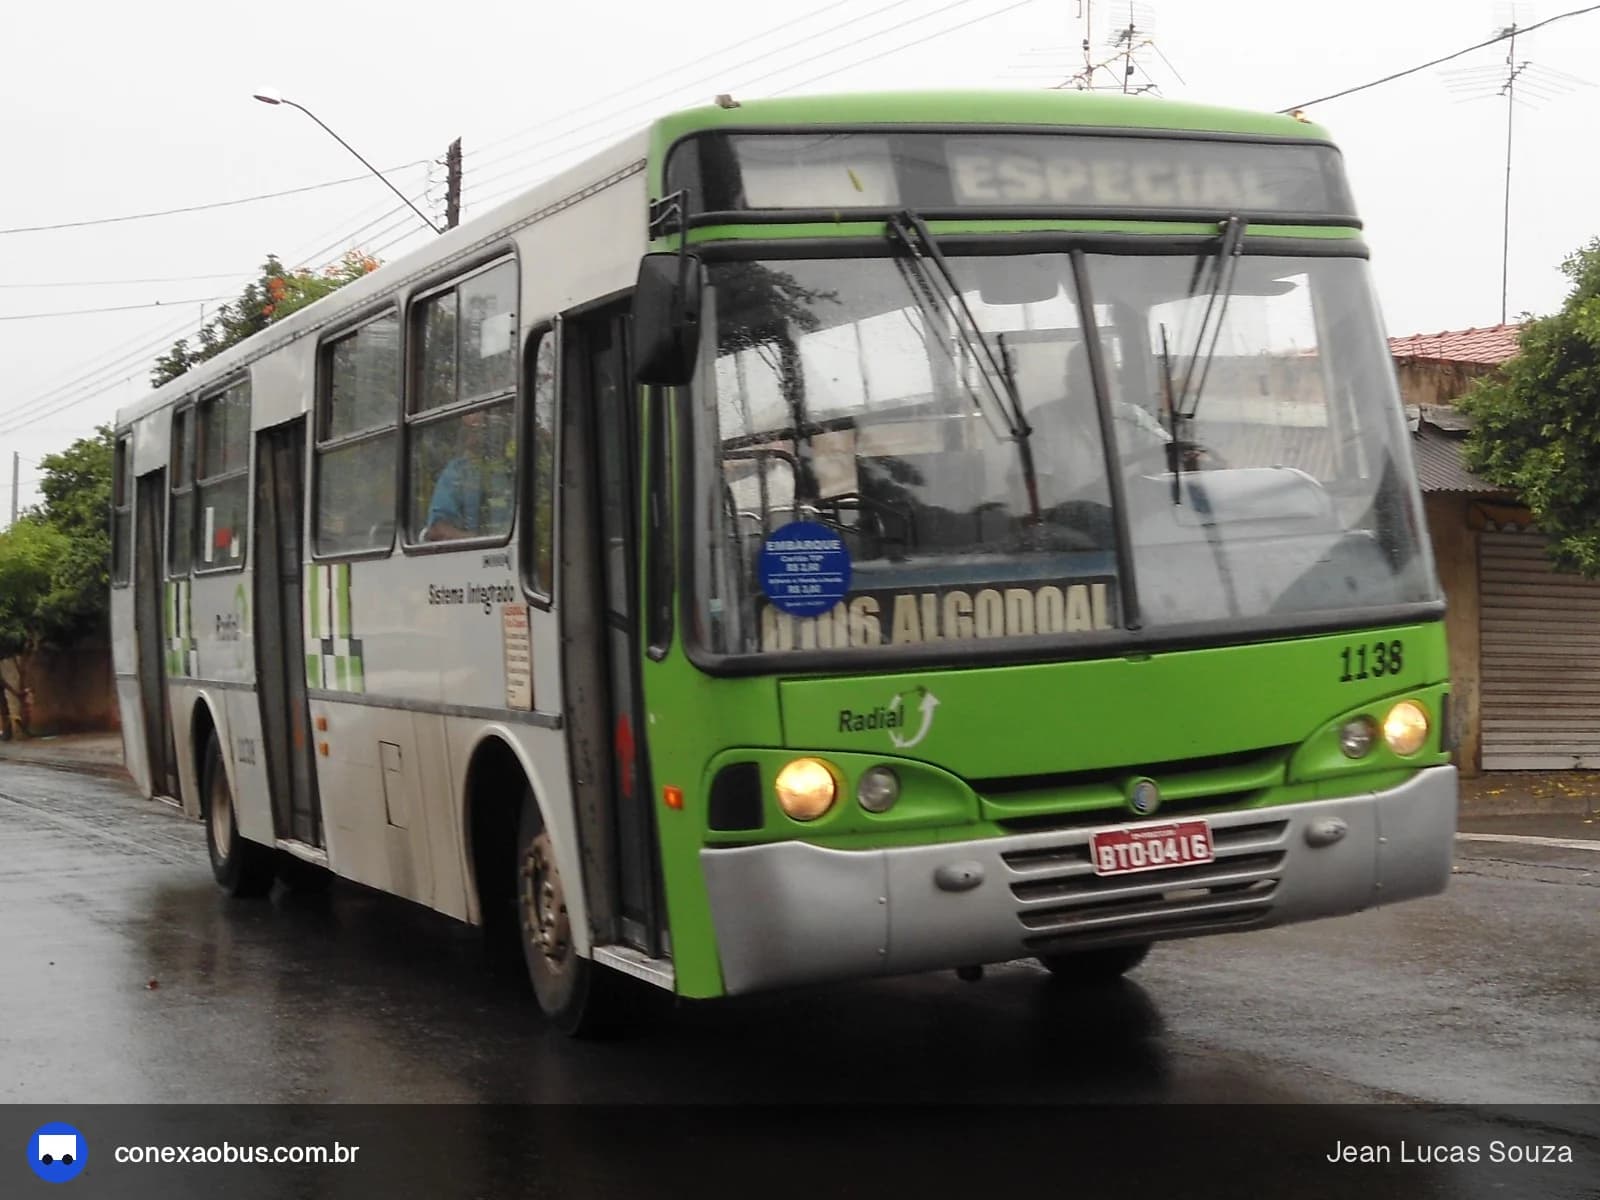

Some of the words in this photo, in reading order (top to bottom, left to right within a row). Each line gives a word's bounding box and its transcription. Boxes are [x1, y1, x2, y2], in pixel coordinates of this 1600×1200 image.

[954, 155, 1280, 208] ESPECIAL
[766, 540, 841, 551] EMBARQUE
[428, 584, 464, 605] Sistema
[467, 580, 515, 615] Integrado
[892, 583, 1114, 644] ALGODOAL
[1339, 640, 1404, 682] 1138
[838, 704, 905, 733] Radial
